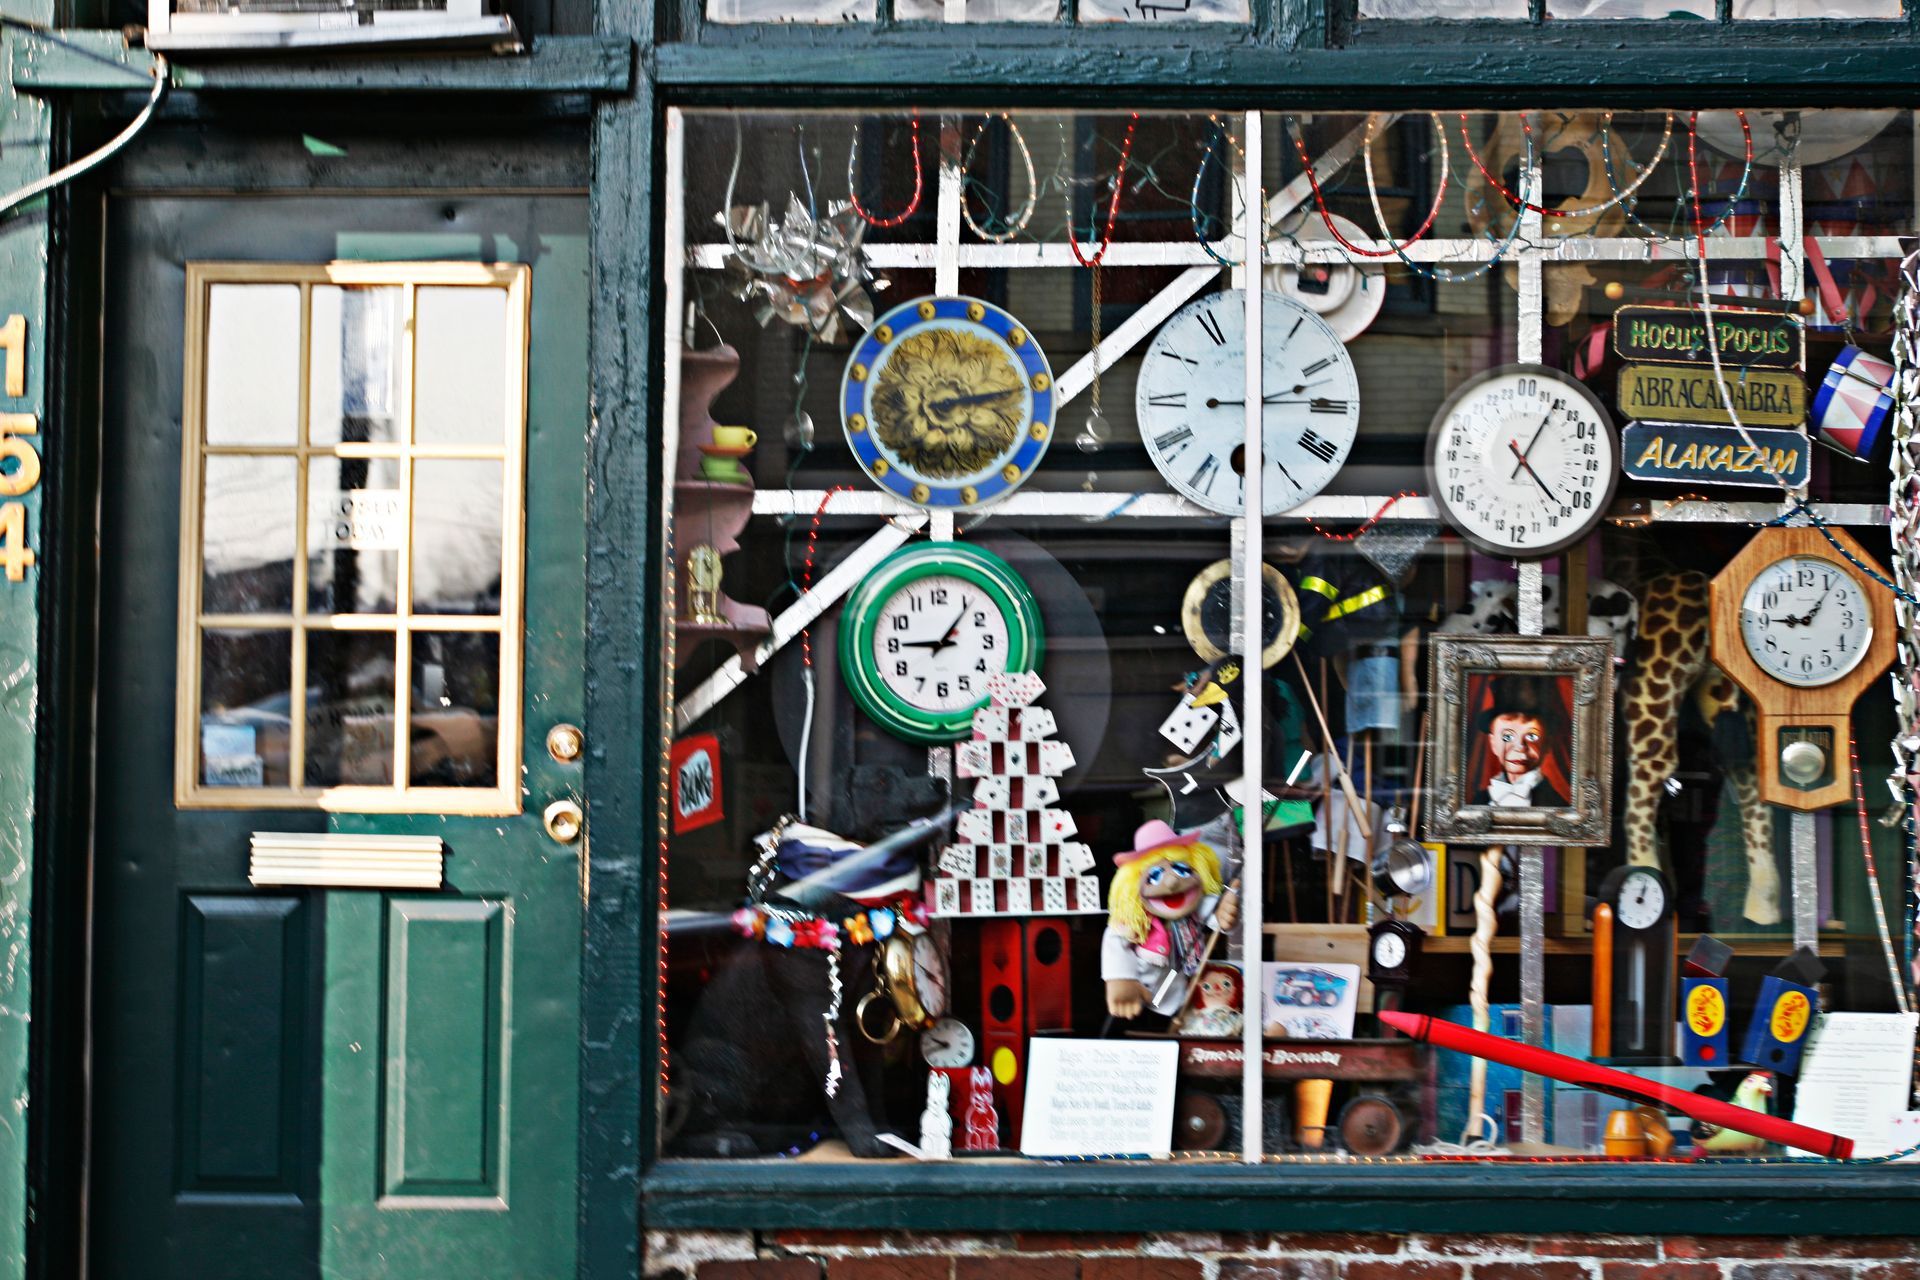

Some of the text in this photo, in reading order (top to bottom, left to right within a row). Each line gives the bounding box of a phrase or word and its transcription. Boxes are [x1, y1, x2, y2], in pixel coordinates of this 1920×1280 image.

[1518, 378, 1537, 397] 00
[1631, 375, 1794, 415] ABRACADABRA
[1576, 421, 1597, 440] 04
[1634, 435, 1800, 476] ALAKAZAM
[1449, 485, 1465, 502] 16
[1572, 490, 1592, 510] 08
[1510, 525, 1526, 543] 12
[1778, 575, 1793, 592] 11
[1797, 570, 1815, 588] 12
[1822, 574, 1830, 591] 1
[911, 596, 922, 612] 11
[931, 590, 948, 606] 12
[962, 594, 969, 611] 1
[1762, 591, 1779, 610] 10
[1835, 589, 1847, 607] 2
[892, 615, 909, 631] 10
[974, 612, 986, 628] 2
[1758, 612, 1770, 632] 9
[1842, 610, 1854, 630] 3
[888, 638, 900, 654] 9
[983, 634, 994, 650] 3
[1765, 635, 1777, 653] 8
[1836, 633, 1847, 652] 4
[975, 658, 987, 673] 4
[1781, 650, 1791, 668] 7
[1801, 654, 1812, 673] 6
[1820, 649, 1832, 667] 5
[896, 661, 908, 676] 8
[914, 677, 926, 693] 7
[937, 682, 949, 698] 6
[959, 676, 970, 691] 5
